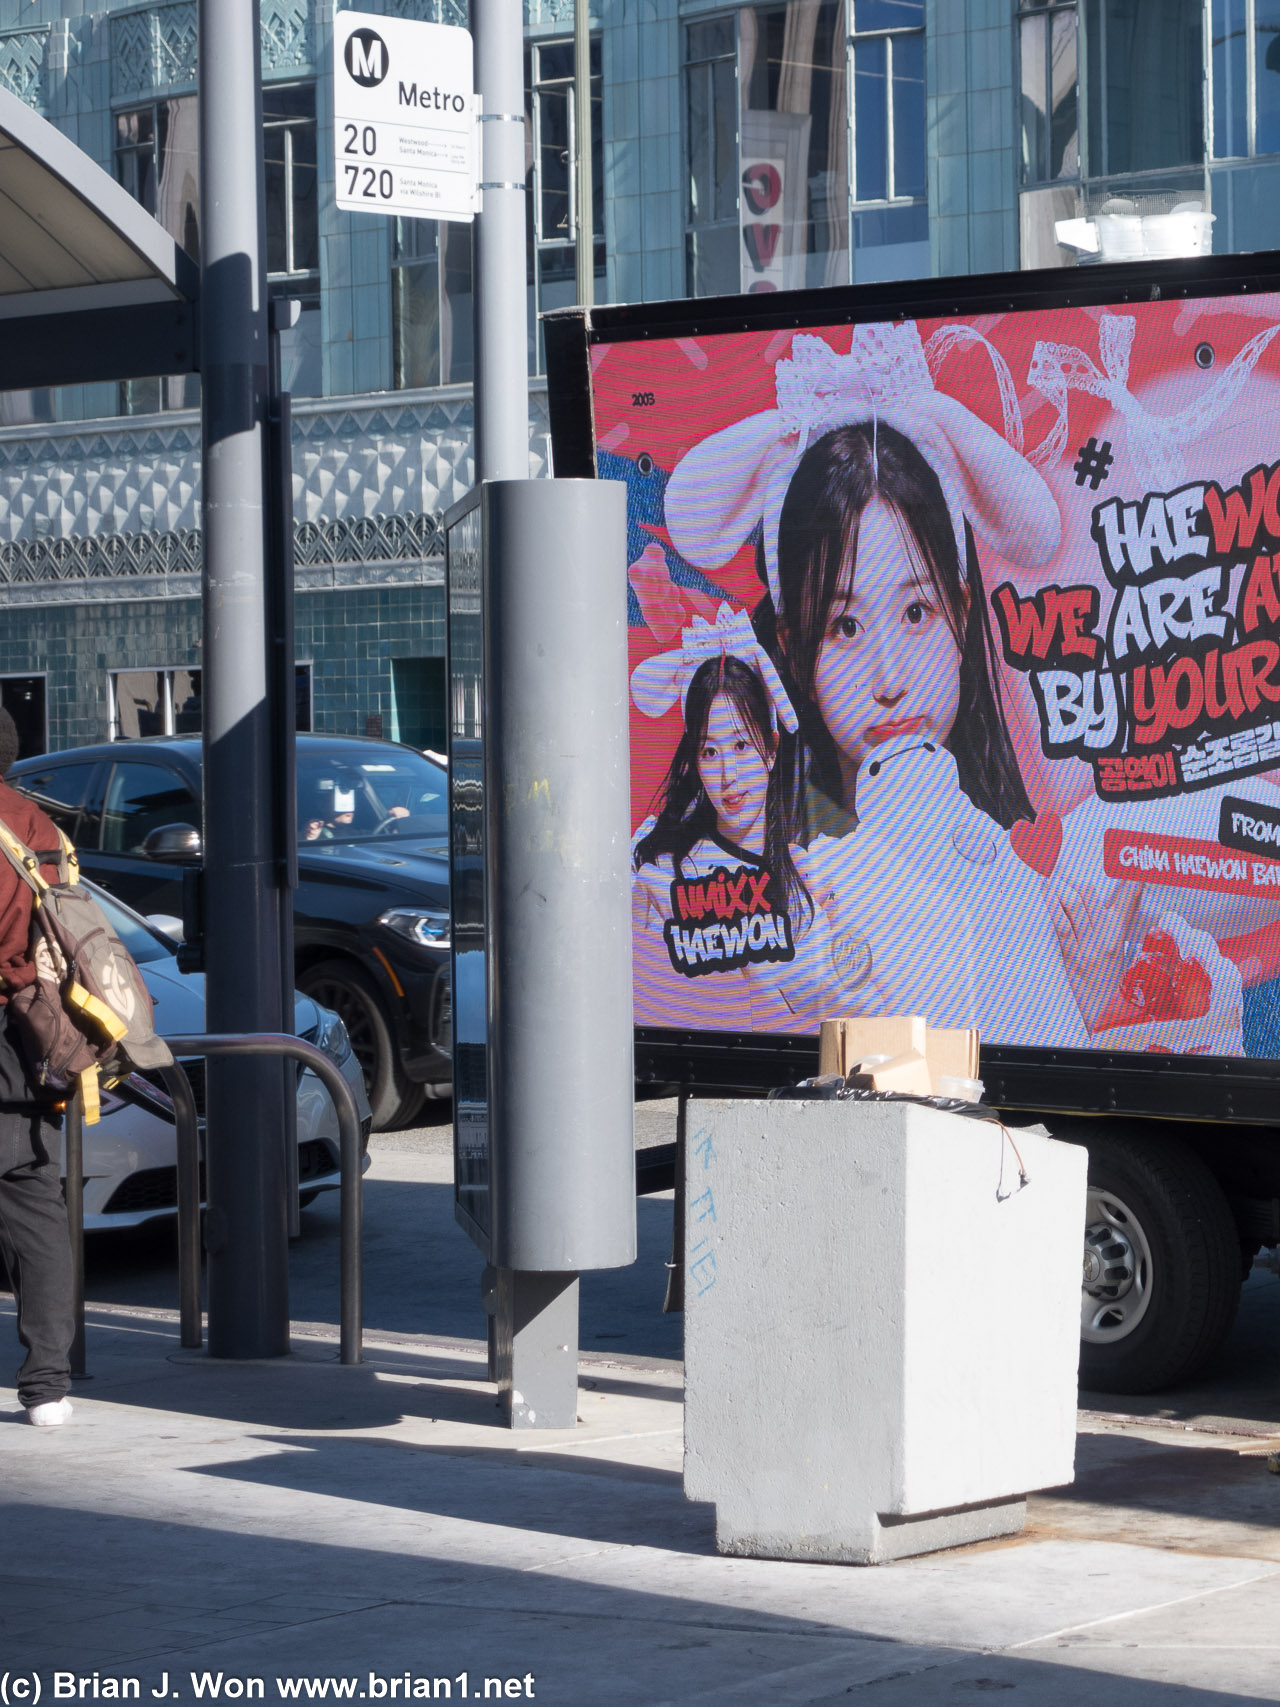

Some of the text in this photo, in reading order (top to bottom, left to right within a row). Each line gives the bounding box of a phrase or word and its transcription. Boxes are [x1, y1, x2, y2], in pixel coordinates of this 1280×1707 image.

[398, 81, 465, 113] Metro
[344, 123, 377, 157] 20
[344, 165, 394, 200] 720
[632, 392, 656, 407] 2003
[998, 586, 1099, 659] WE
[1112, 564, 1228, 659] ARE
[1036, 668, 1119, 748] BY
[1097, 751, 1177, 792] 공연이
[1173, 851, 1248, 882] HAEWON
[669, 912, 789, 965] HAEWON
